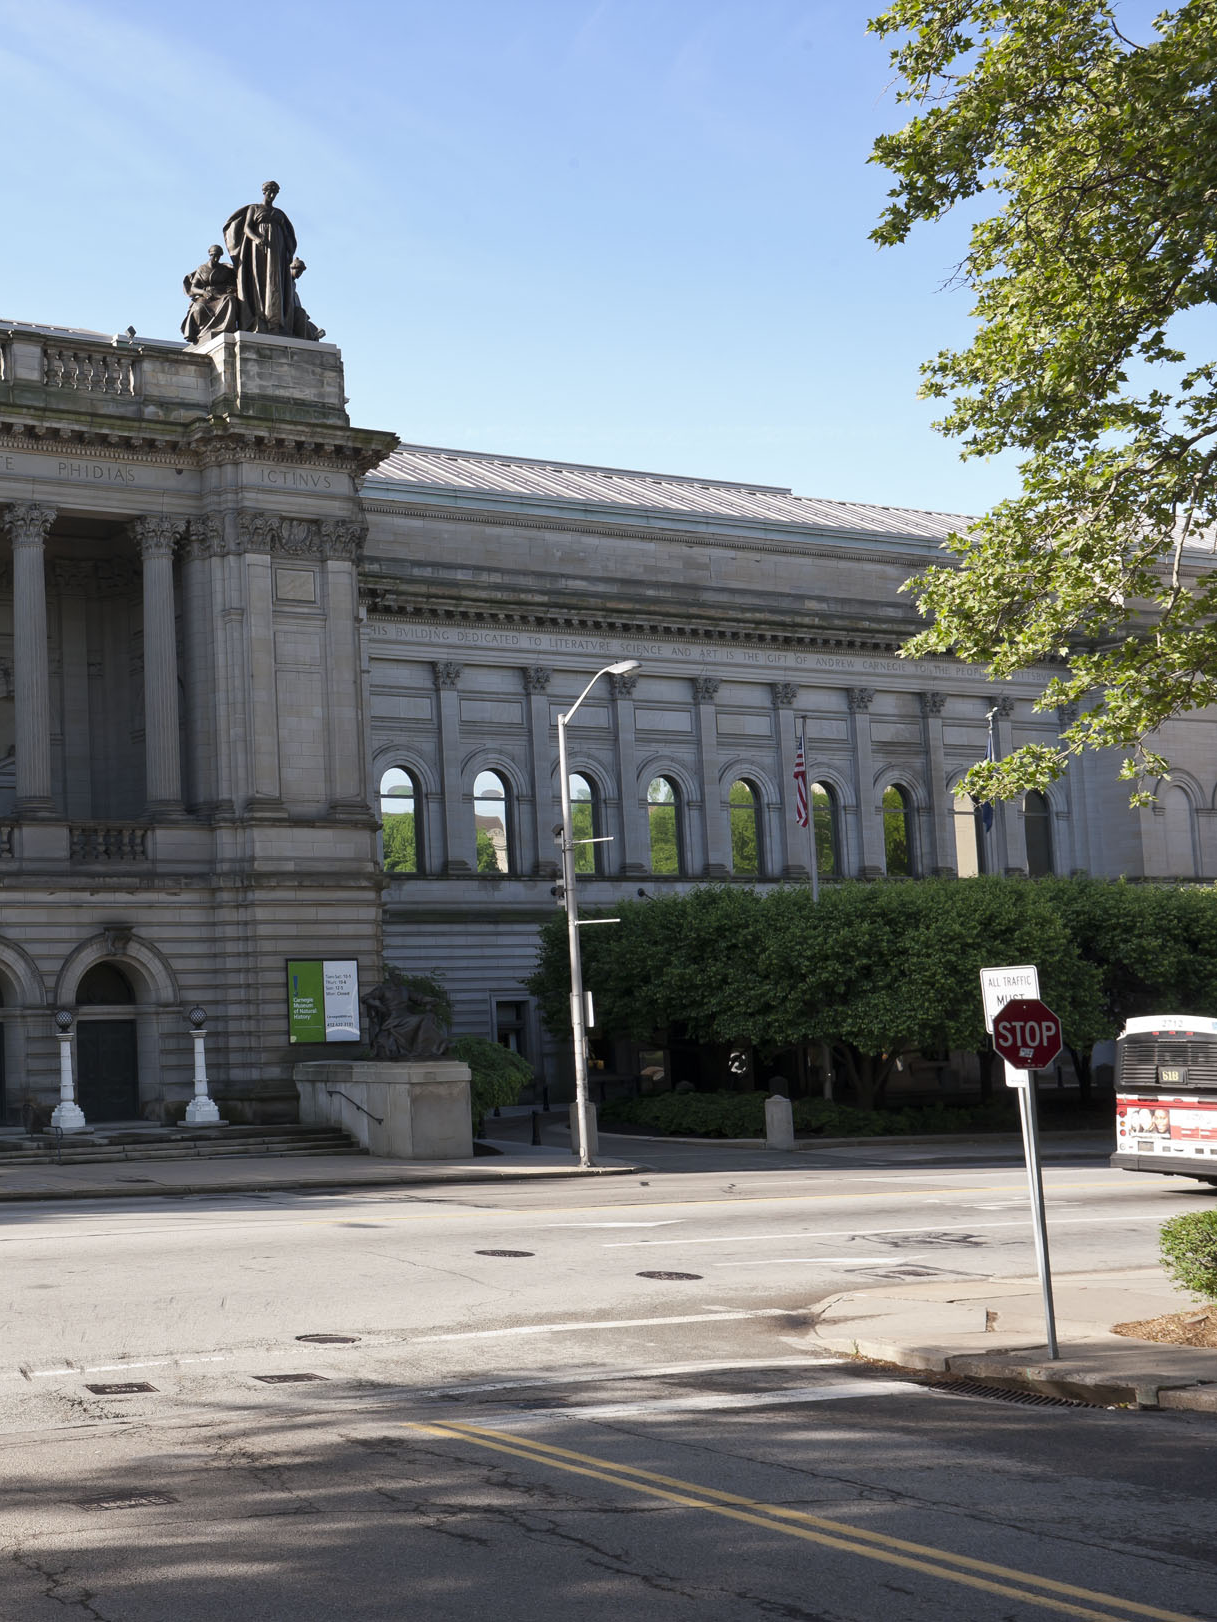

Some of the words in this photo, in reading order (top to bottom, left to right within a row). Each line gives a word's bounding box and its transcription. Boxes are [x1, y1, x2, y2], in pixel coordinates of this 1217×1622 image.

[58, 462, 136, 482] PHIDIAS
[261, 469, 331, 489] ICTINVS
[457, 631, 519, 645] DEDICATED
[527, 637, 542, 646] TO
[620, 643, 663, 655] SCIENCE
[671, 647, 692, 657] AND
[699, 649, 717, 659] ART
[726, 651, 734, 660] IS
[743, 652, 760, 662] THE
[767, 654, 788, 664] GIFT
[796, 656, 808, 665] OF
[815, 658, 856, 669] ANDREW
[862, 661, 907, 672] CARNEGIE
[914, 664, 926, 673] TO
[934, 665, 950, 675] THE
[988, 978, 1001, 987] ALL
[1003, 975, 1032, 986] TRAFFIC
[998, 1020, 1057, 1048] STOP
